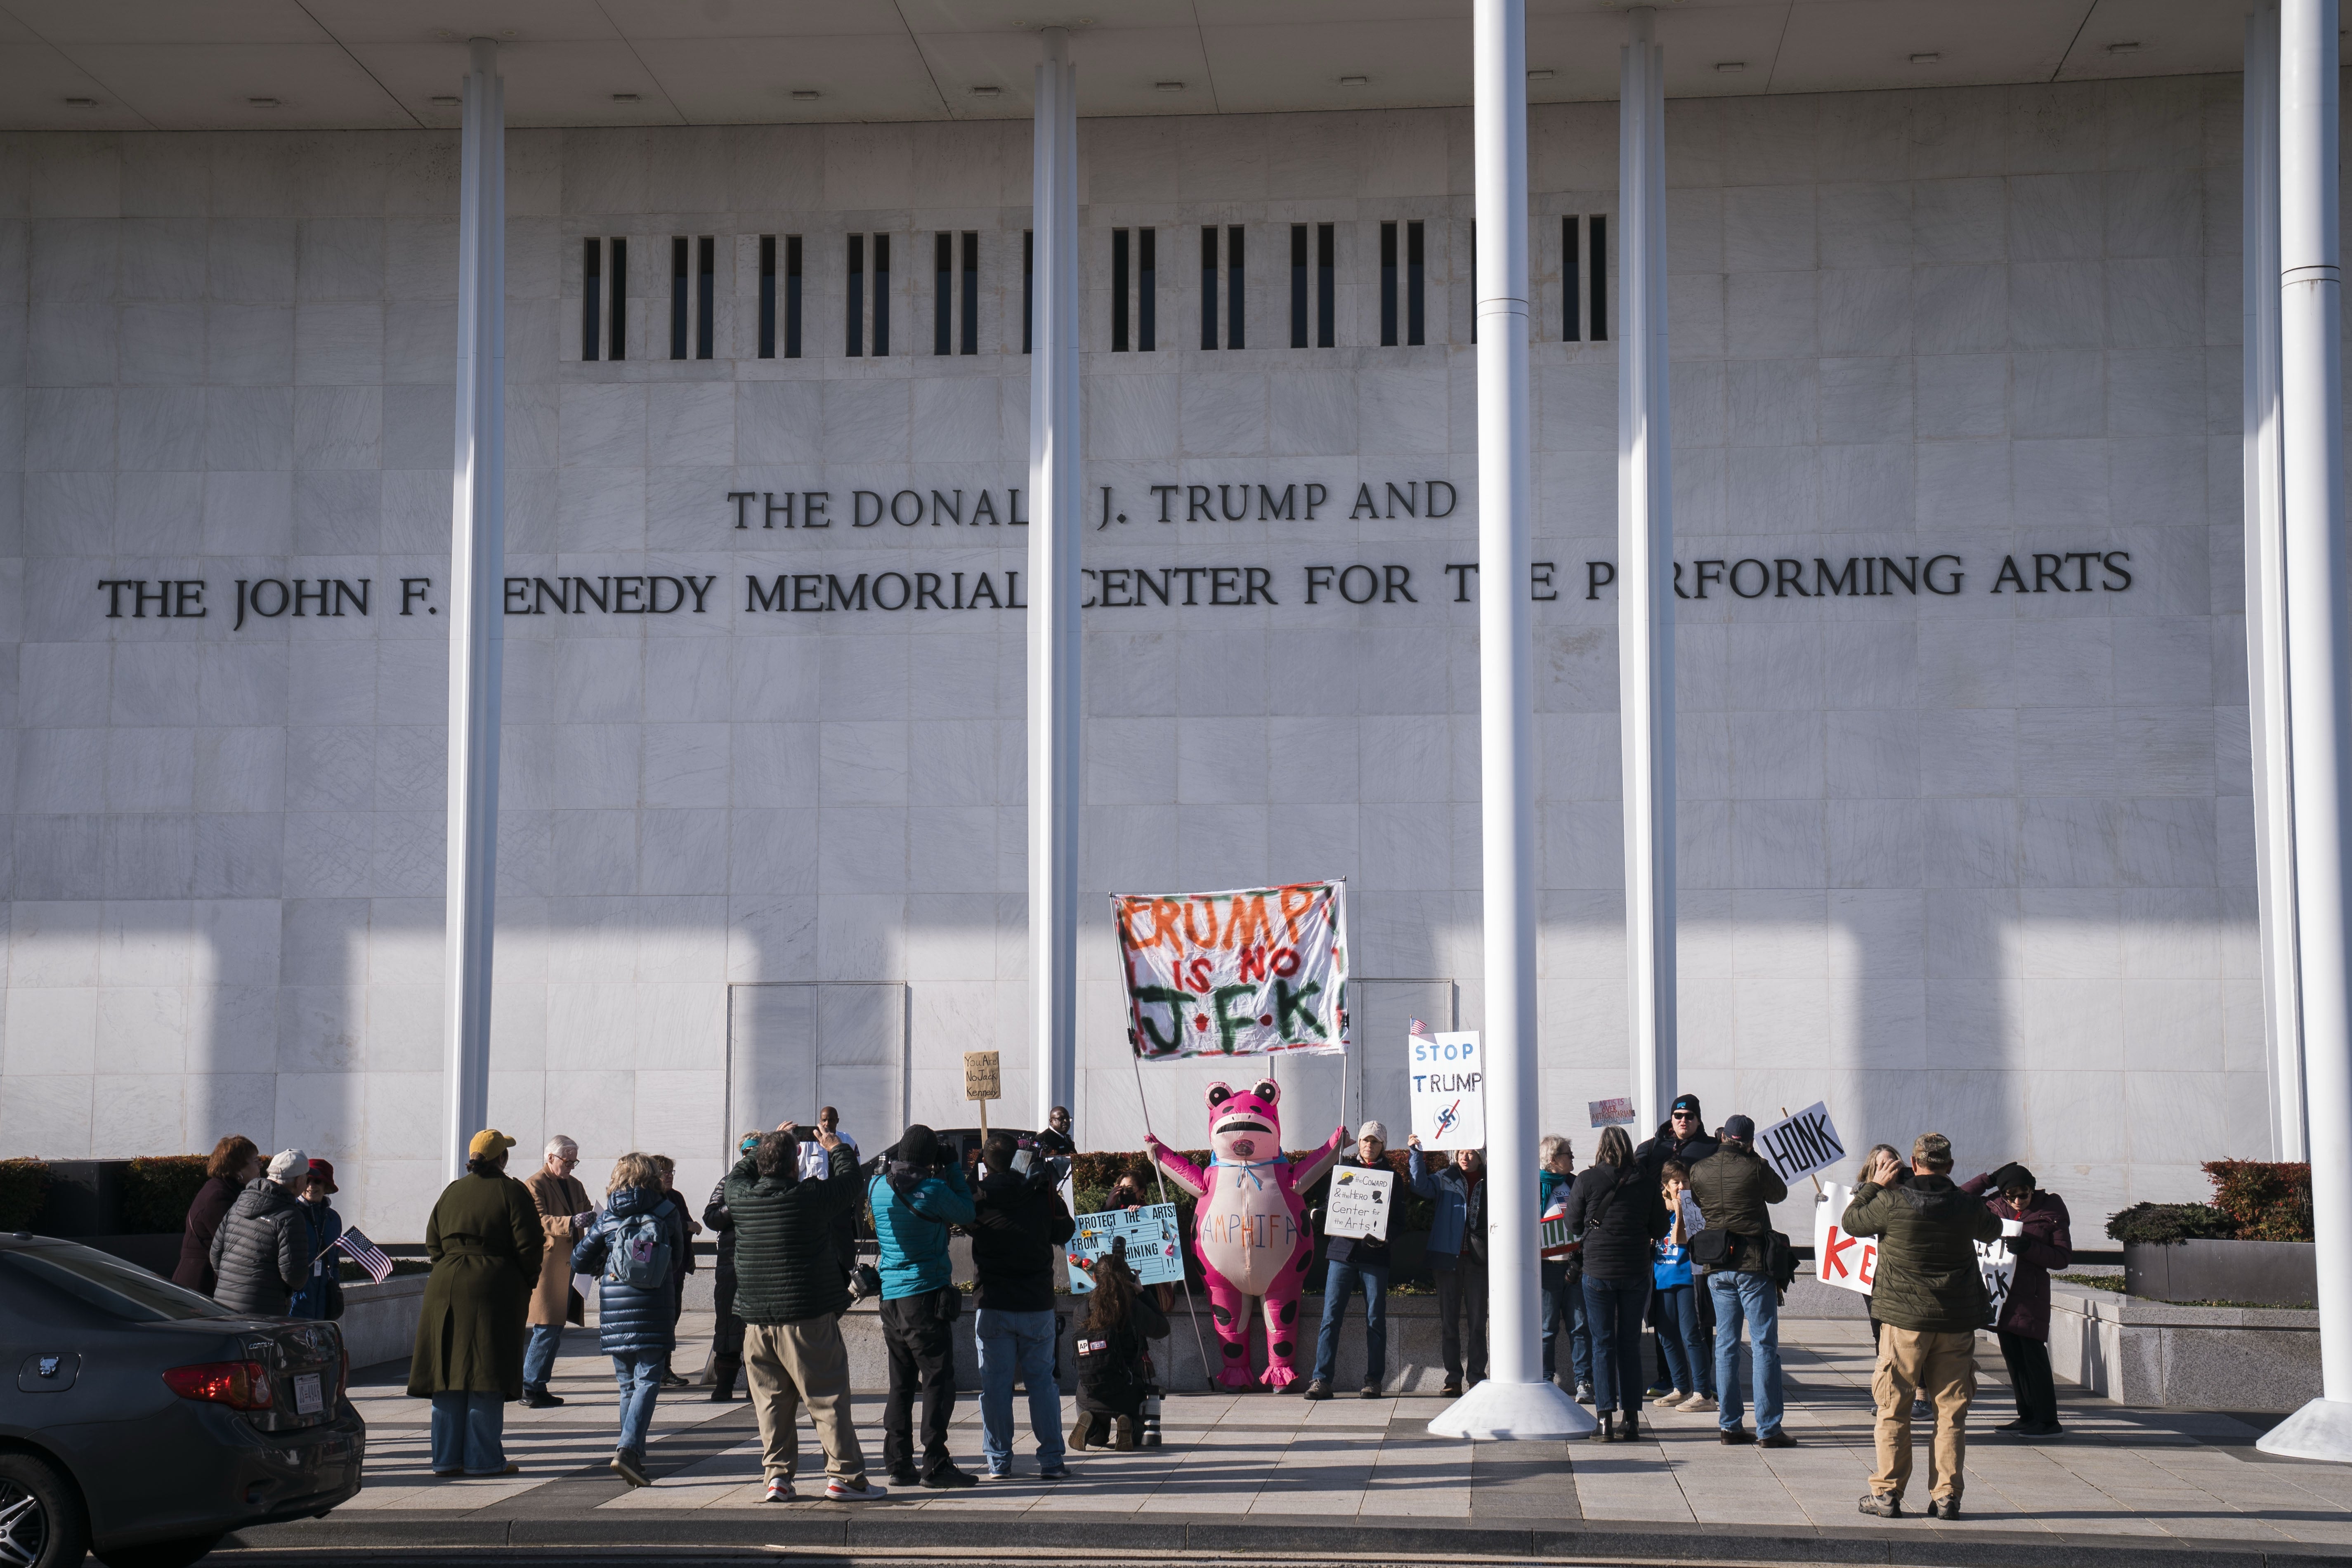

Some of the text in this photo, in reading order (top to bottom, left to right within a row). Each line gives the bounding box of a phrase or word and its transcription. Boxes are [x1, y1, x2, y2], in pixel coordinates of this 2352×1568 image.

[727, 481, 1457, 531] THE DONAL J. TRUMP AND
[97, 579, 207, 618] THE
[233, 579, 371, 631] JOHN
[399, 578, 437, 615] F.
[504, 576, 716, 614] ENNEDY
[745, 571, 1028, 612] MEMORIAL
[1304, 564, 1418, 604] FOR
[1445, 562, 1557, 602] TE
[1586, 555, 1965, 600] PFORMING
[1990, 551, 2132, 593] ARTS
[1172, 945, 1301, 993] IS NO
[964, 1055, 997, 1067] You Are
[1415, 1044, 1473, 1061] STOP
[966, 1070, 997, 1082] No Jack
[1413, 1072, 1481, 1092] TRUMP
[966, 1086, 998, 1098] Kennedy
[1599, 1098, 1624, 1108] ARTISTS
[1762, 1112, 1844, 1181] HONK
[1363, 1176, 1387, 1187] COWARD
[1334, 1188, 1341, 1197] &
[1350, 1189, 1367, 1200] HERO
[1078, 1205, 1176, 1230] PROTECT THE ARTS!
[1332, 1202, 1370, 1216] Center
[1203, 1214, 1303, 1249] AMPHIFA
[1072, 1236, 1098, 1251] FROM
[1124, 1243, 1158, 1260] HINING
